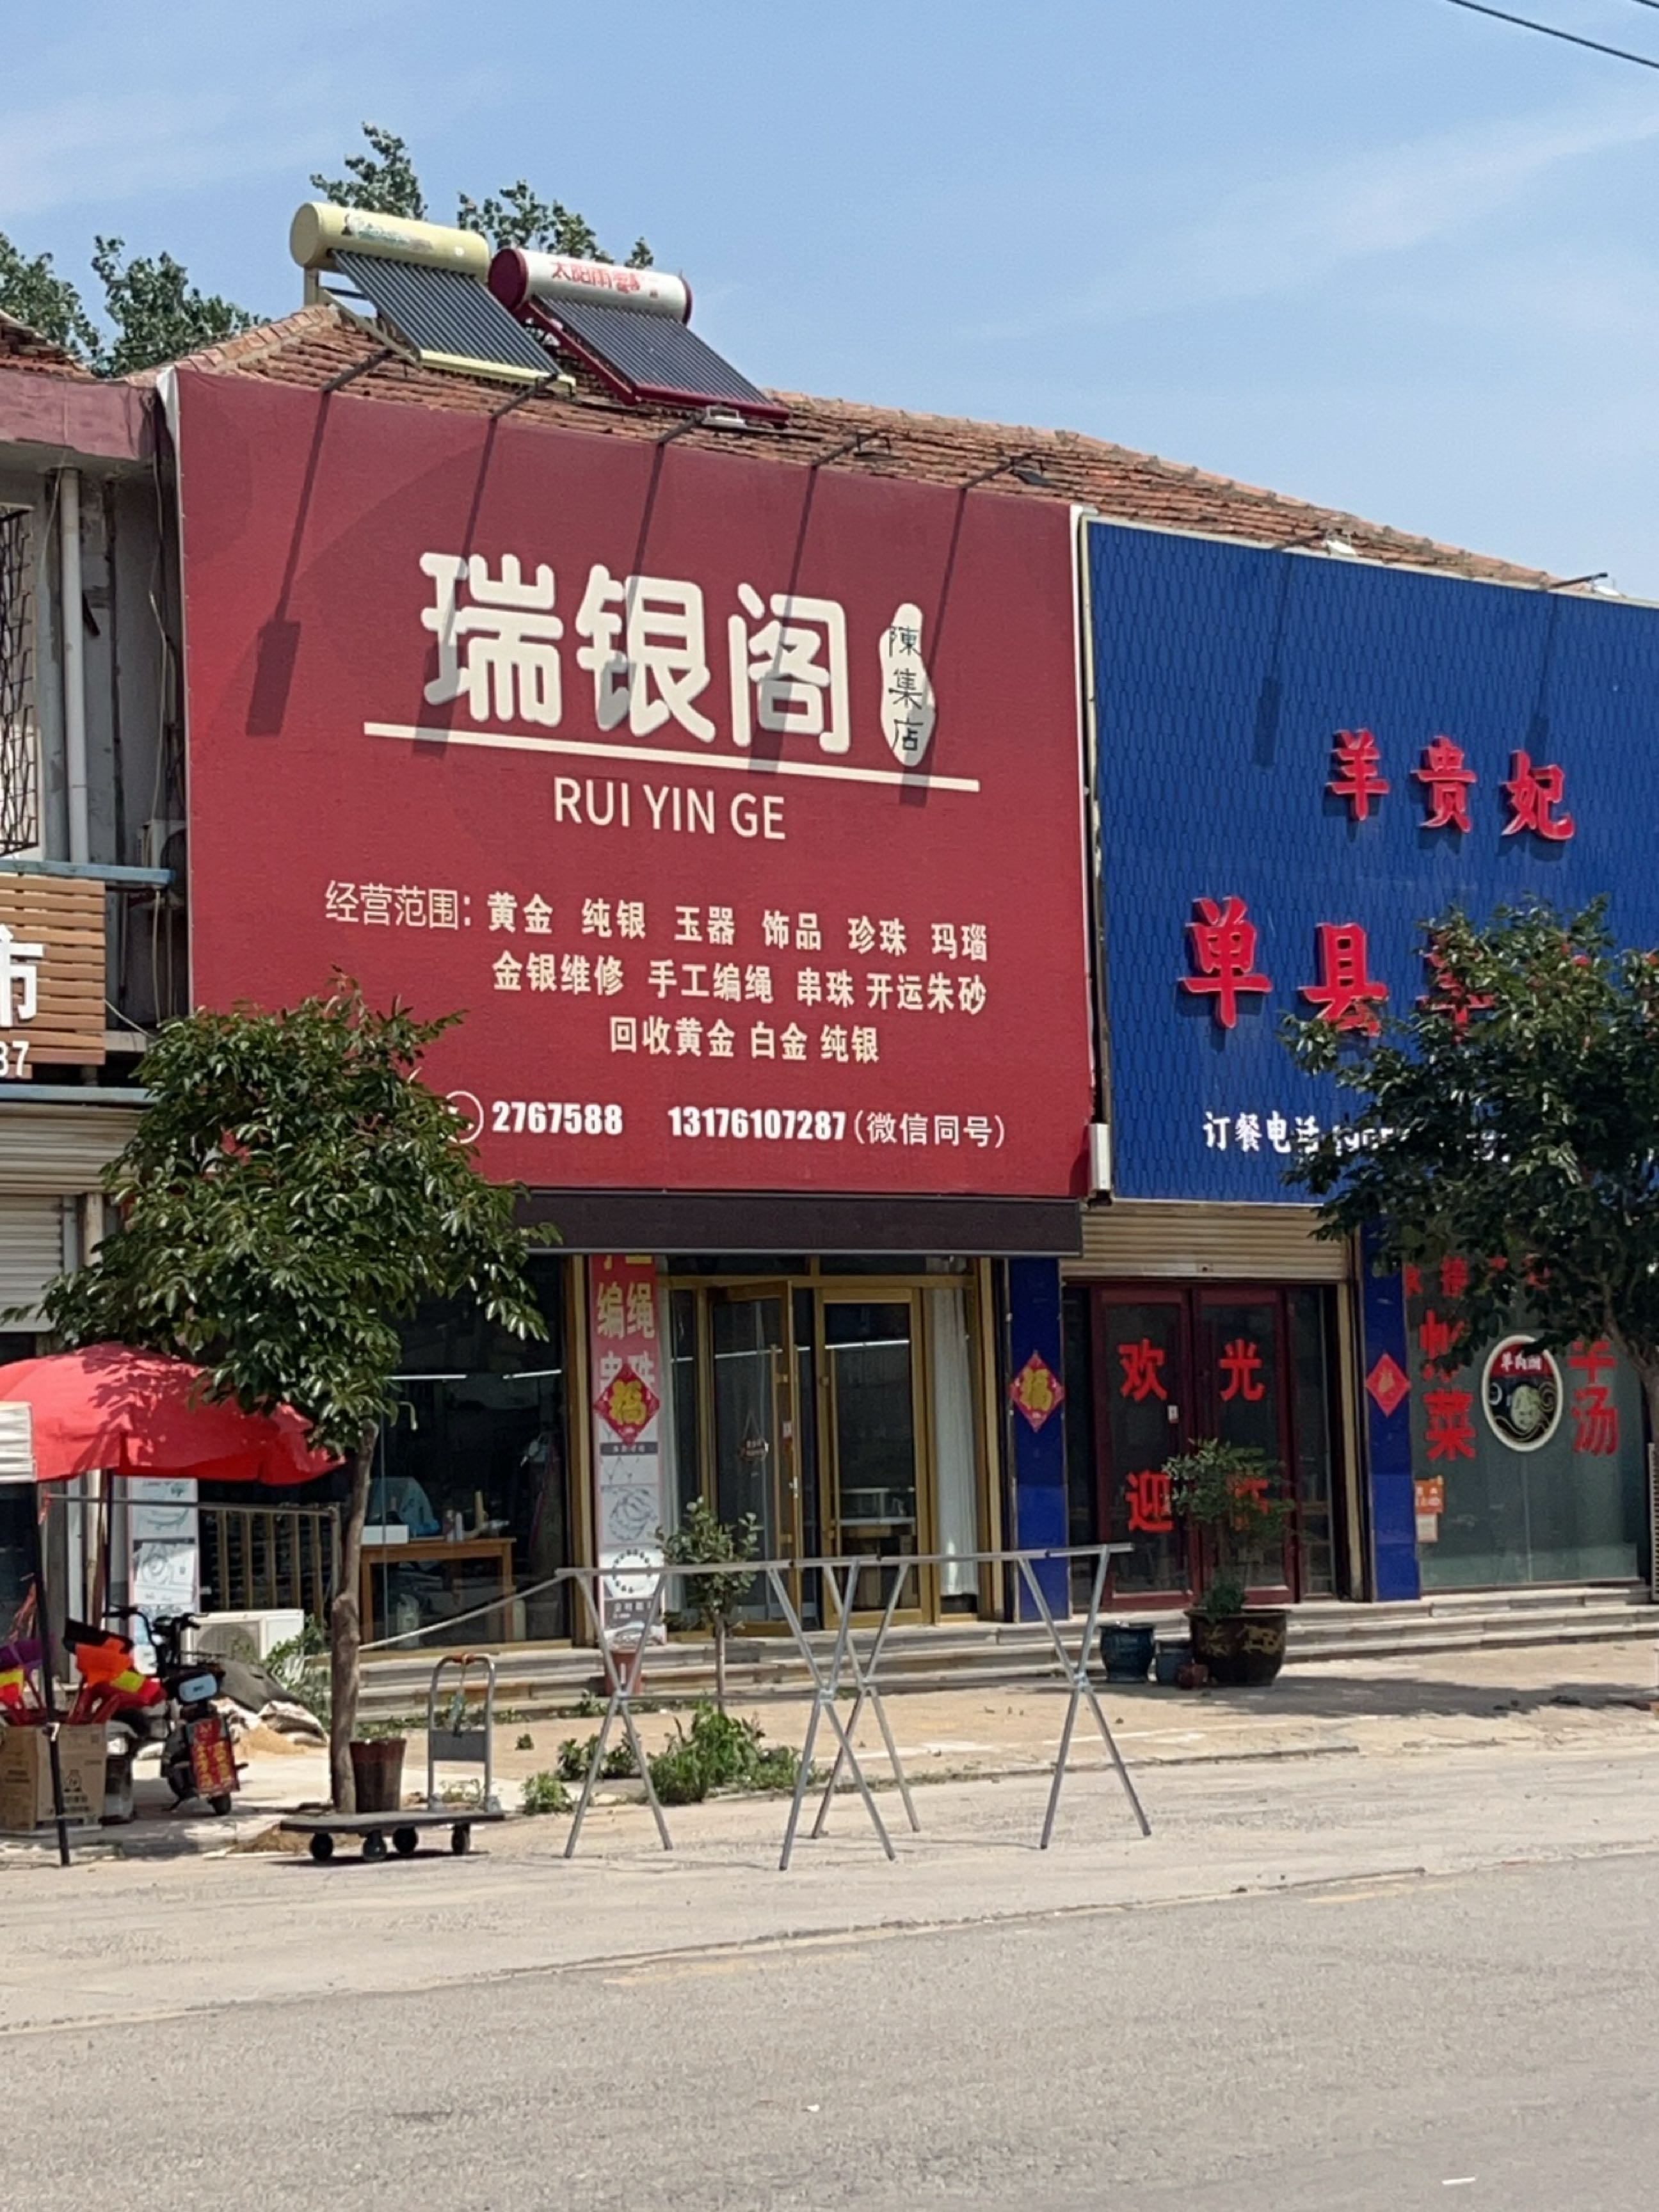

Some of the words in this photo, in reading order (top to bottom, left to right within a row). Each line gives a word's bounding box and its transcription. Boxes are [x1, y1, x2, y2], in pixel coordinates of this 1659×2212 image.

[419, 551, 850, 754] 瑞银阁
[888, 625, 924, 751] 陳集店
[554, 776, 630, 827] RUI
[643, 783, 716, 834] YIN
[730, 792, 786, 840] GE
[1327, 728, 1575, 840] 羊贵妃
[486, 890, 554, 934] 黄金
[581, 897, 646, 939] 纯银
[674, 905, 735, 945] 玉器
[761, 909, 822, 951] 饰品
[847, 915, 907, 957] 珍珠
[930, 922, 988, 961] 玛瑙
[492, 950, 624, 996] 金银维修
[648, 959, 774, 1004] 手工编绳
[796, 966, 855, 1008] 串珠
[865, 972, 987, 1015] 开运朱砂
[609, 1016, 735, 1057] 回收黄金
[750, 1020, 808, 1061] 白金
[819, 1024, 880, 1064] 纯银
[492, 1100, 623, 1135] 2767588
[597, 1281, 655, 1340] 编绳
